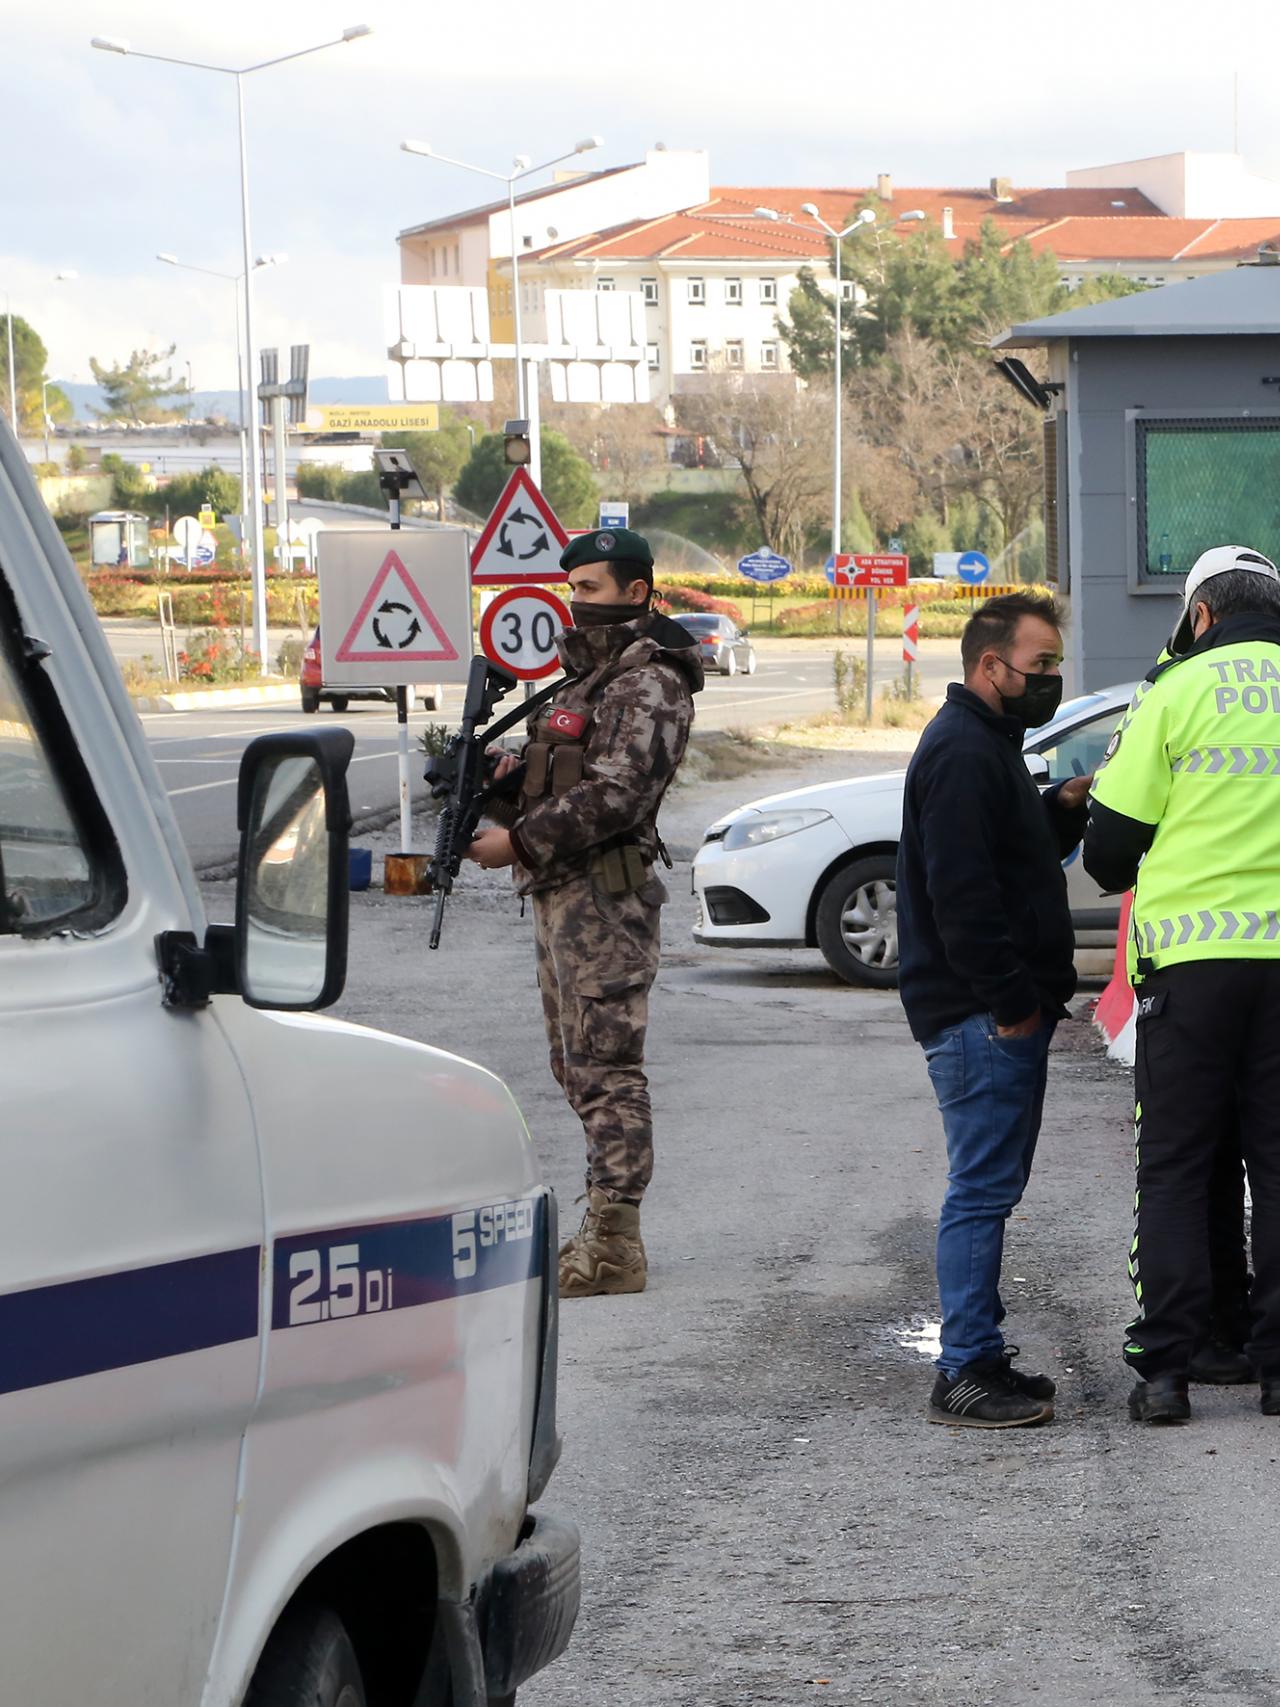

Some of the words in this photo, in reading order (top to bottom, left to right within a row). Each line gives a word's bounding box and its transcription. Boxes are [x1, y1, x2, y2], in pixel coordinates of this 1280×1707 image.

[329, 417, 351, 428] GAZİ
[354, 418, 398, 427] ANADOLU
[400, 416, 429, 427] LİSESİ
[501, 611, 555, 653] 30
